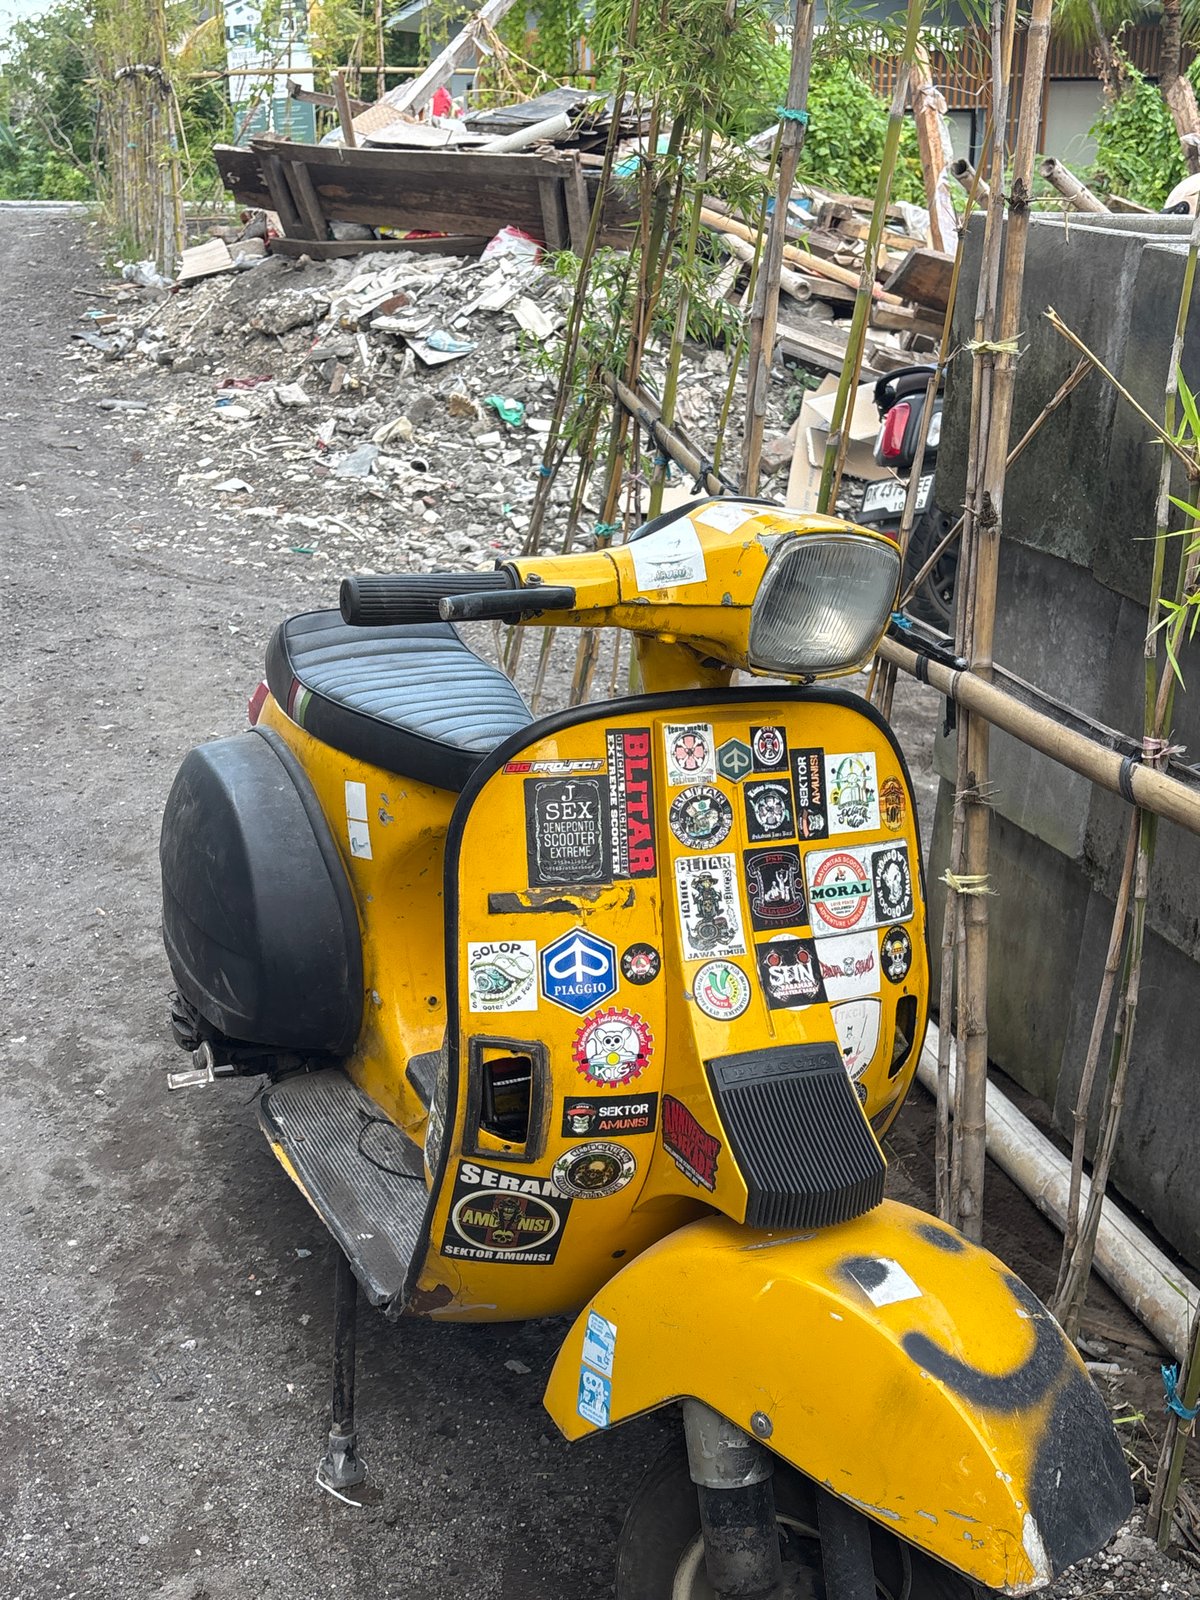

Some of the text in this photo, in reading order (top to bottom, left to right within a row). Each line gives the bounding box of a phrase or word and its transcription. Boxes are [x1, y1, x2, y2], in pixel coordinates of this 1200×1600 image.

[533, 761, 602, 772] PROJECT
[797, 756, 809, 807] SEKTOR
[809, 755, 821, 805] AMUNISI
[561, 785, 575, 801] J
[545, 801, 594, 820] SEX
[607, 734, 620, 874] EXTREME SCOOTER
[616, 734, 628, 873] OFFICIAL MERCHANDISE
[624, 733, 655, 873] BLITAR
[543, 820, 595, 833] JENEPONTO
[543, 831, 595, 848] SCOOTER
[550, 845, 592, 858] EXTREME
[676, 855, 731, 873] BLITAR
[816, 856, 863, 883] MAYORITAS SCOOTER
[811, 883, 871, 900] MORAL
[472, 943, 522, 960] SOLOP
[687, 947, 745, 959] JAWA TIMUR
[769, 961, 815, 985] SEIN
[554, 983, 607, 996] PIAGGIO
[599, 1103, 649, 1117] SEKTOR
[599, 1117, 649, 1130] AMUNISI
[460, 1163, 569, 1200] SERAM
[445, 1245, 552, 1262] SEKTOR AMUNISI
